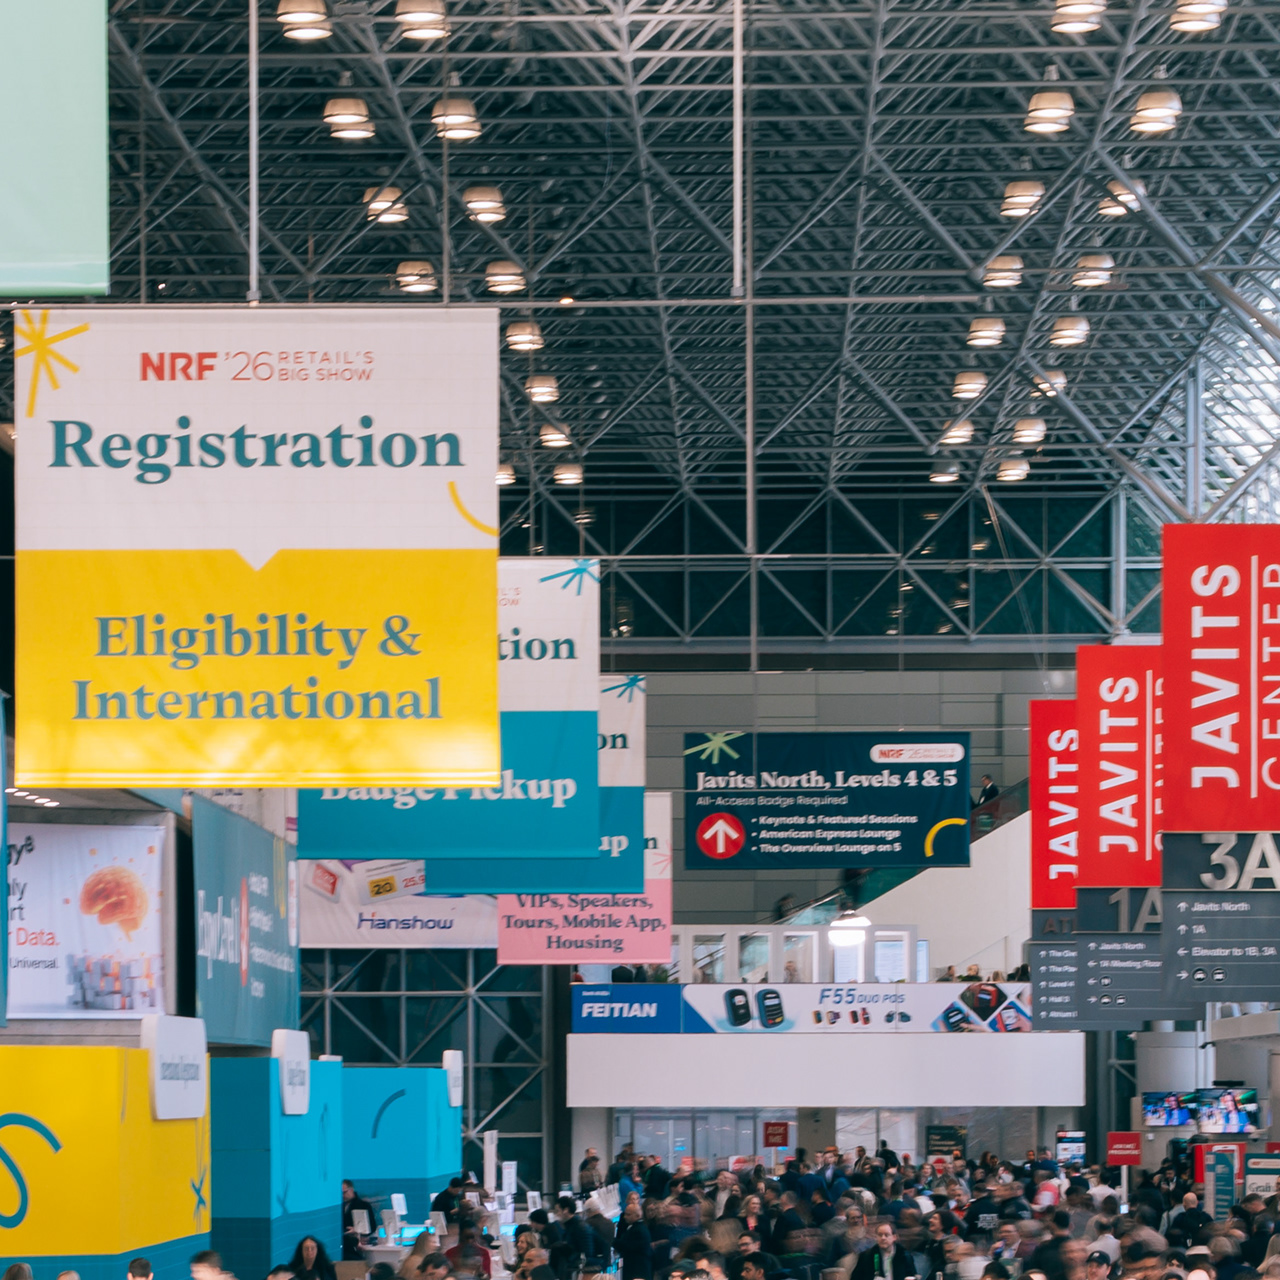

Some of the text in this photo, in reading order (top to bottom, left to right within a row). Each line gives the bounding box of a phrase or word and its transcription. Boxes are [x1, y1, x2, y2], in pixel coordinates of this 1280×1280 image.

[140, 351, 218, 382] NRF
[277, 350, 375, 364] RETAIL'S
[277, 367, 375, 381] BIG SHOW
[47, 414, 466, 485] Registration
[94, 612, 423, 670] Eligibility &
[1190, 564, 1242, 789] JAVITS
[72, 676, 444, 721] International
[1098, 676, 1139, 853] JAVITS
[695, 768, 959, 791] Javits North, Levels 4 & 5
[757, 795, 796, 809] Badge
[796, 794, 849, 808] Required
[1047, 728, 1079, 880] JAVITS
[758, 814, 807, 828] Keynote
[817, 814, 869, 825] Featured
[869, 813, 919, 825] Sessions
[758, 828, 902, 842] American Express Lounge
[759, 842, 780, 854] The
[834, 842, 877, 856] Lounge
[566, 893, 654, 913] Speakers,
[1191, 901, 1251, 912] Javits North
[357, 911, 454, 930] Hanshow
[502, 913, 668, 934] Tours, Mobile App,
[545, 933, 625, 953] Housing
[1191, 946, 1231, 957] Elevator
[818, 987, 858, 1006] F55
[581, 1002, 658, 1018] FEITIAN
